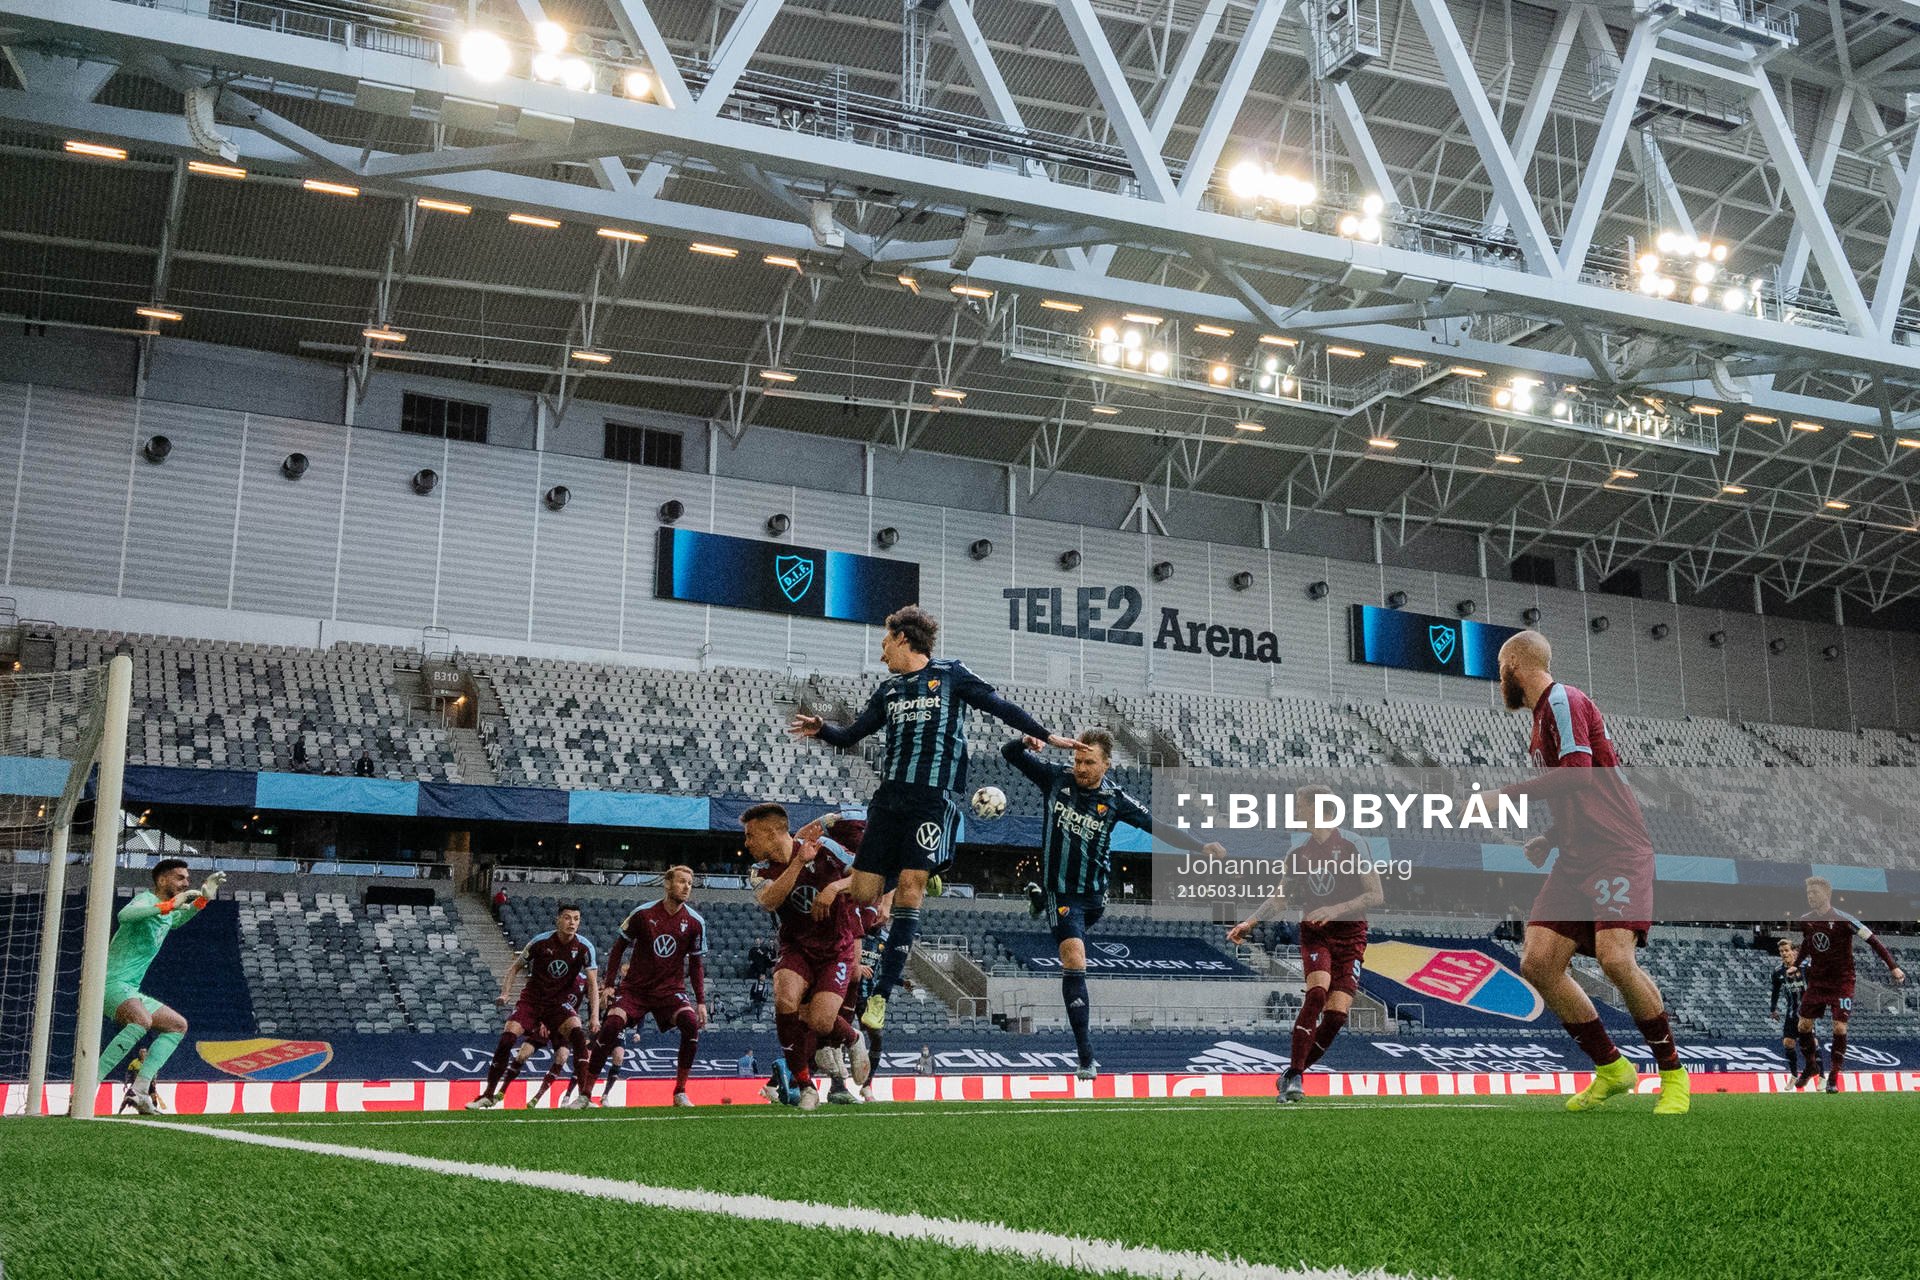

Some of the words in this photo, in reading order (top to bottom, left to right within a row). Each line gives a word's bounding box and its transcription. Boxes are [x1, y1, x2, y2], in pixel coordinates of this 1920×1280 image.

[1003, 585, 1143, 647] TELE2
[1153, 607, 1282, 664] Arena
[434, 671, 459, 682] B310
[888, 696, 941, 714] Prioritet
[892, 710, 932, 724] Finans
[1054, 800, 1105, 833] Prioritet
[1594, 876, 1631, 905] 32
[836, 961, 847, 981] 3
[1839, 998, 1852, 1011] 10
[1371, 1042, 1564, 1058] Prioritet
[1422, 1056, 1568, 1072] Finans
